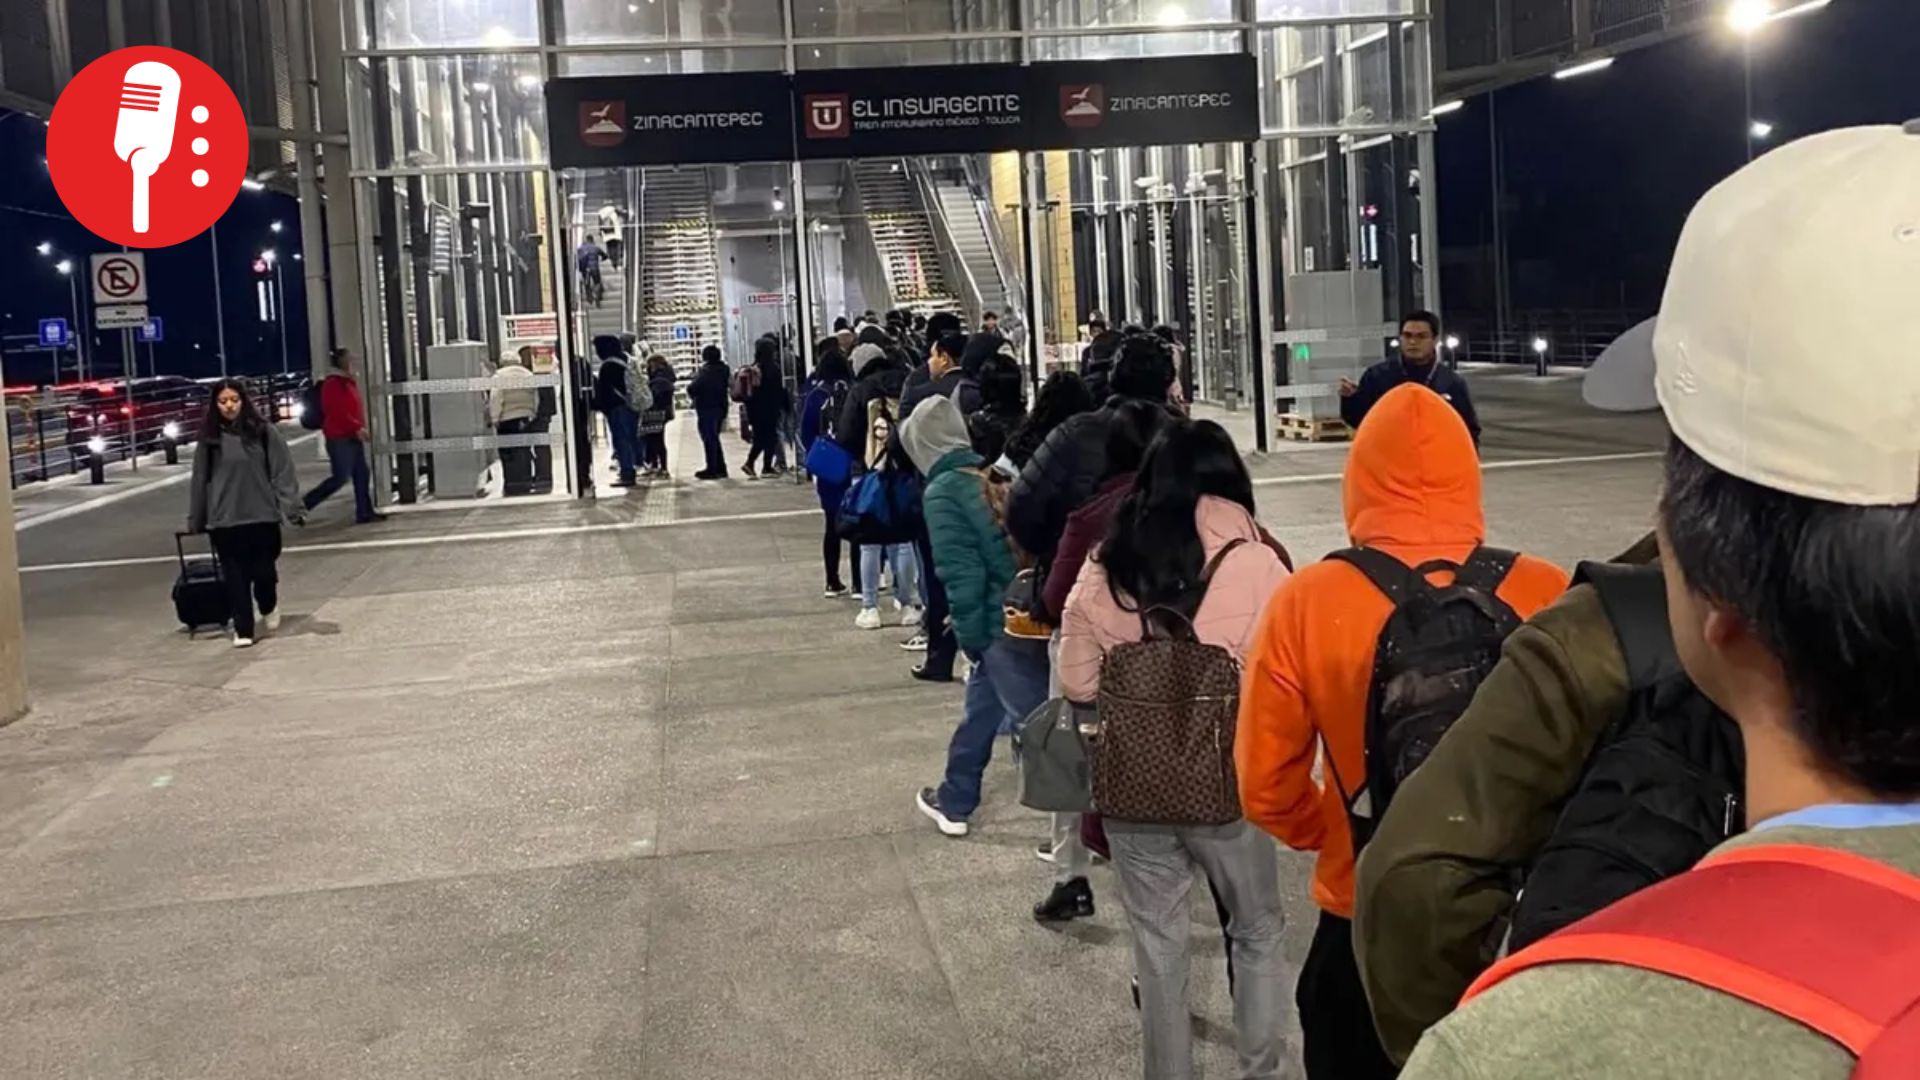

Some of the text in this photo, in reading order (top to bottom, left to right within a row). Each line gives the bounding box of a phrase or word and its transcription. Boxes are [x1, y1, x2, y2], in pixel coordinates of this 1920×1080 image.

[852, 94, 1020, 117] EL INSURGENTE
[1109, 92, 1232, 111] ZINACANTEPEC
[633, 111, 763, 130] ZINACANTEPEC
[985, 115, 1020, 125] TOLUCA
